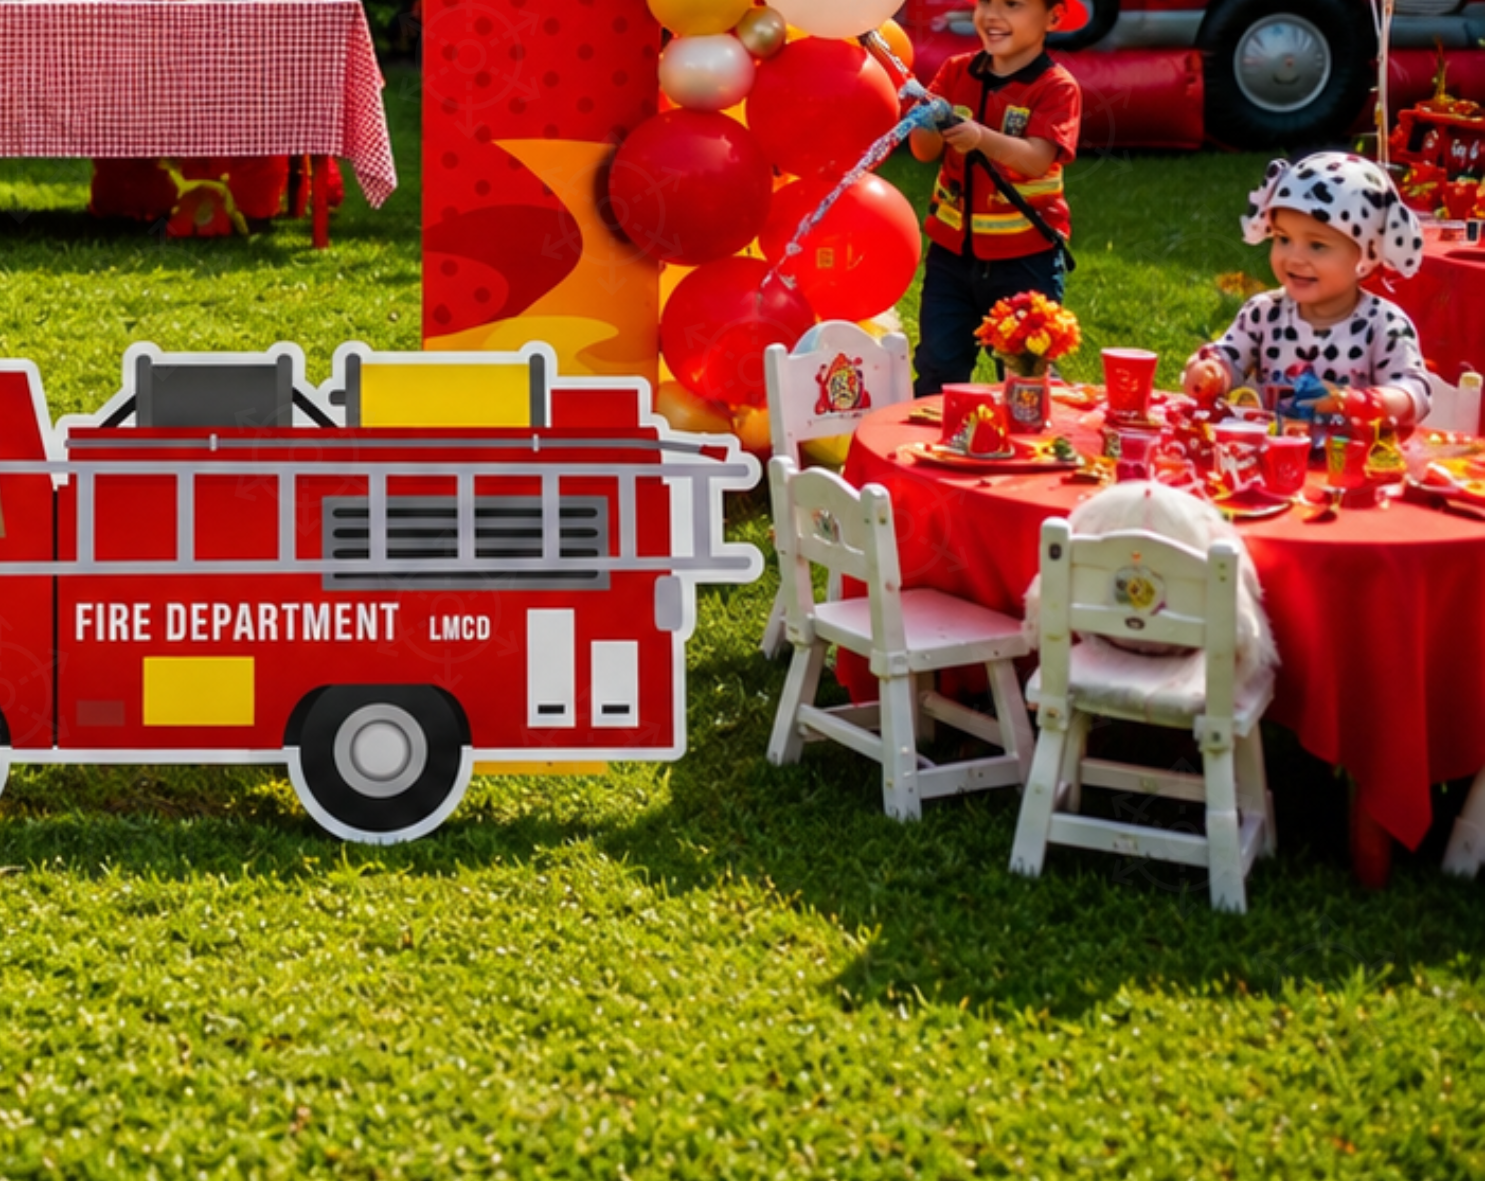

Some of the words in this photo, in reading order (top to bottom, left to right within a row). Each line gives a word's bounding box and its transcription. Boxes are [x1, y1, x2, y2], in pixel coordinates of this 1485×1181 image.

[75, 602, 152, 642] FIRE
[166, 602, 400, 642] DEPARTMENT
[429, 615, 491, 641] LMCD
